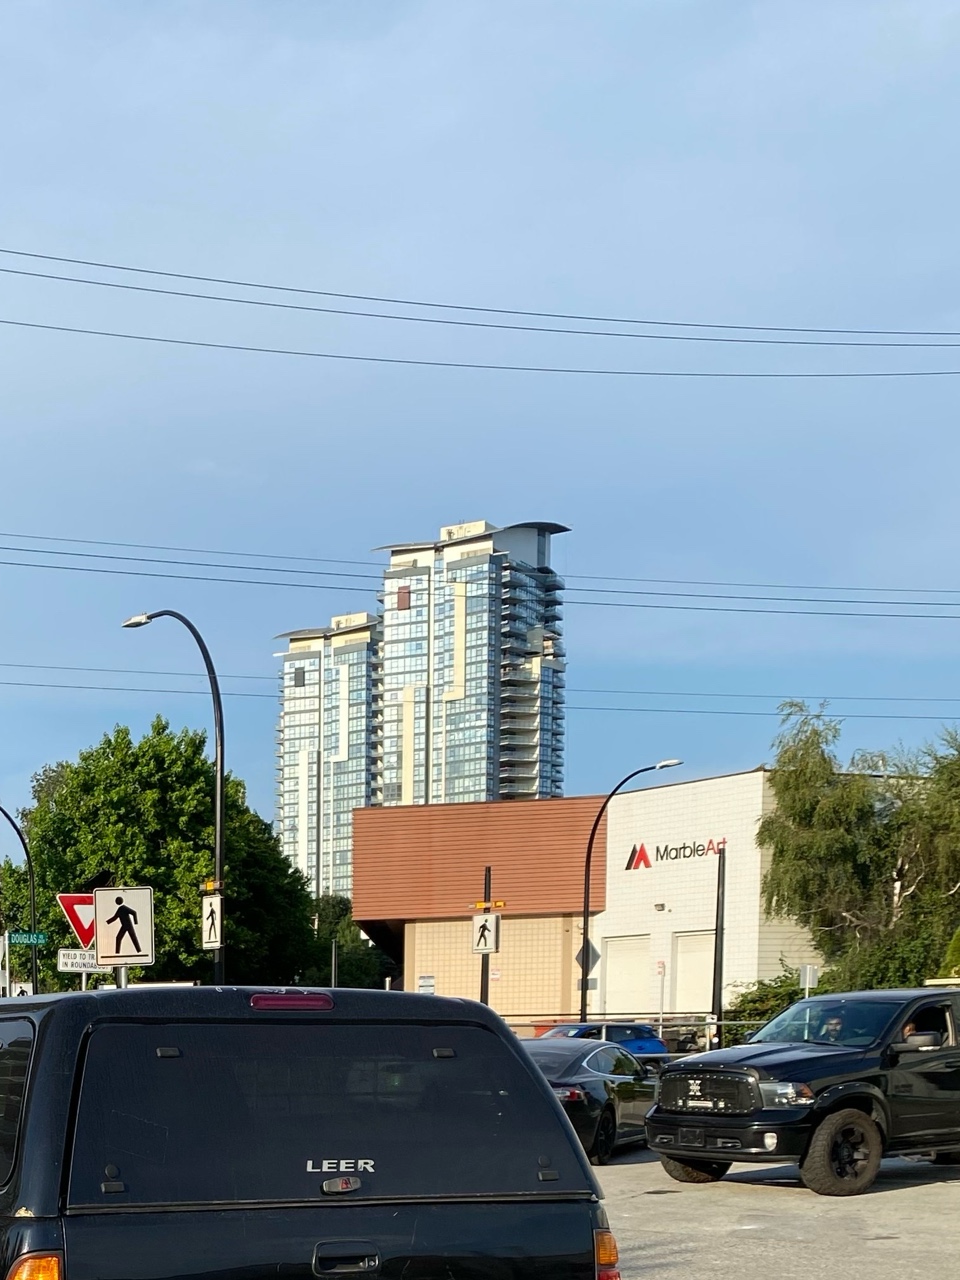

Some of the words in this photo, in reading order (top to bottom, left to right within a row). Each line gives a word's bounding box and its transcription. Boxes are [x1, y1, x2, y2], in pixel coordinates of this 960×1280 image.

[655, 837, 727, 861] MarbleArt
[11, 934, 37, 944] DOUGLAS
[306, 1159, 375, 1173] LEER
